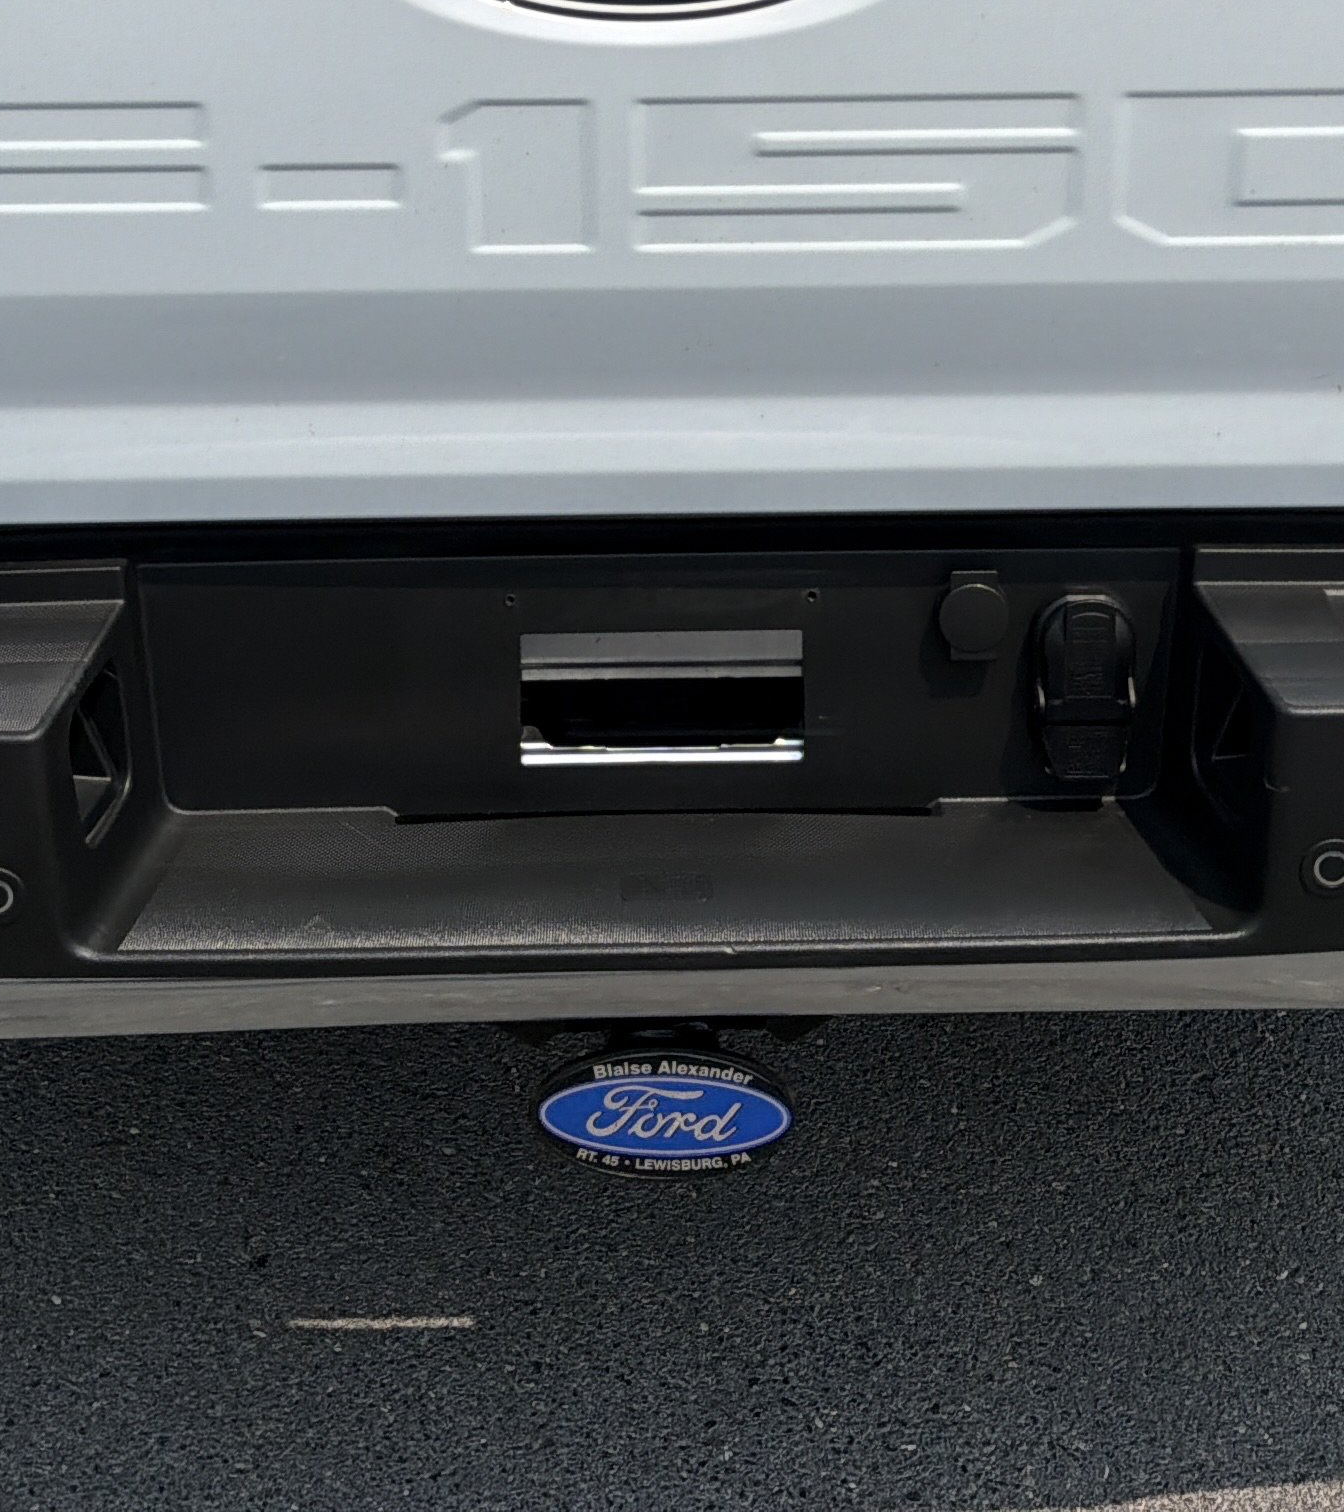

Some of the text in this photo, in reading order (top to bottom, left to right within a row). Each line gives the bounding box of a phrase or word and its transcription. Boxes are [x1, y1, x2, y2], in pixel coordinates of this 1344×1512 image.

[592, 1060, 754, 1086] Blaise Alexander
[586, 1085, 742, 1143] Ford
[576, 1147, 599, 1163] RT.
[601, 1154, 619, 1167] 45
[731, 1151, 752, 1165] PA
